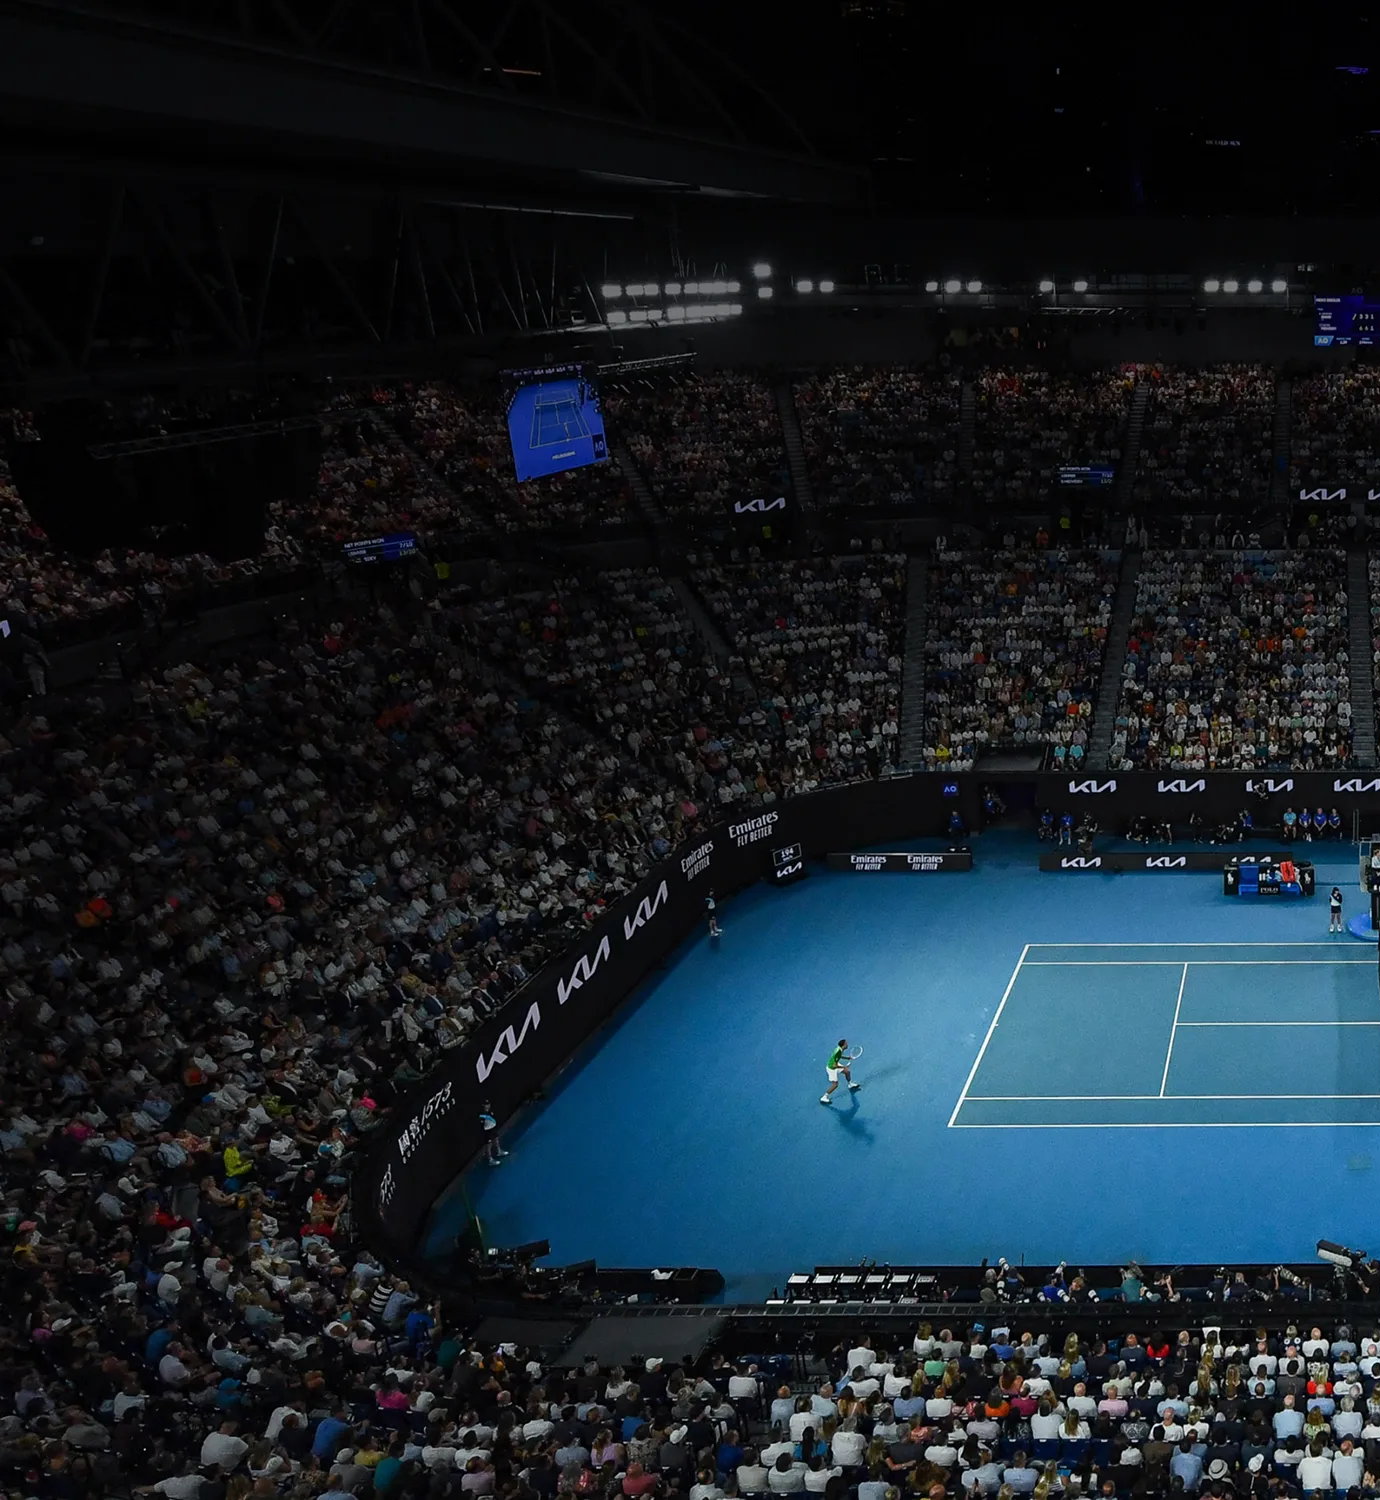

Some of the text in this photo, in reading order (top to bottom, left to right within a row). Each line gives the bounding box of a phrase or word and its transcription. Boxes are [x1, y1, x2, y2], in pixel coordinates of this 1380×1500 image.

[1300, 488, 1346, 500] KIA
[734, 497, 785, 513] KIA
[1069, 780, 1117, 793] KIA
[1158, 779, 1206, 793] KIA
[728, 810, 779, 839] Emirates
[737, 824, 773, 847] FLY BETTER
[681, 840, 714, 873] Emirates
[781, 847, 794, 858] 194
[851, 855, 887, 863] Emirates
[907, 855, 943, 863] Emirates
[776, 861, 803, 878] KIA
[1061, 857, 1101, 868] KIA
[1146, 856, 1186, 868] KIA
[623, 879, 669, 941] KIA
[557, 935, 611, 1005] KIA
[476, 1001, 541, 1084] KIA
